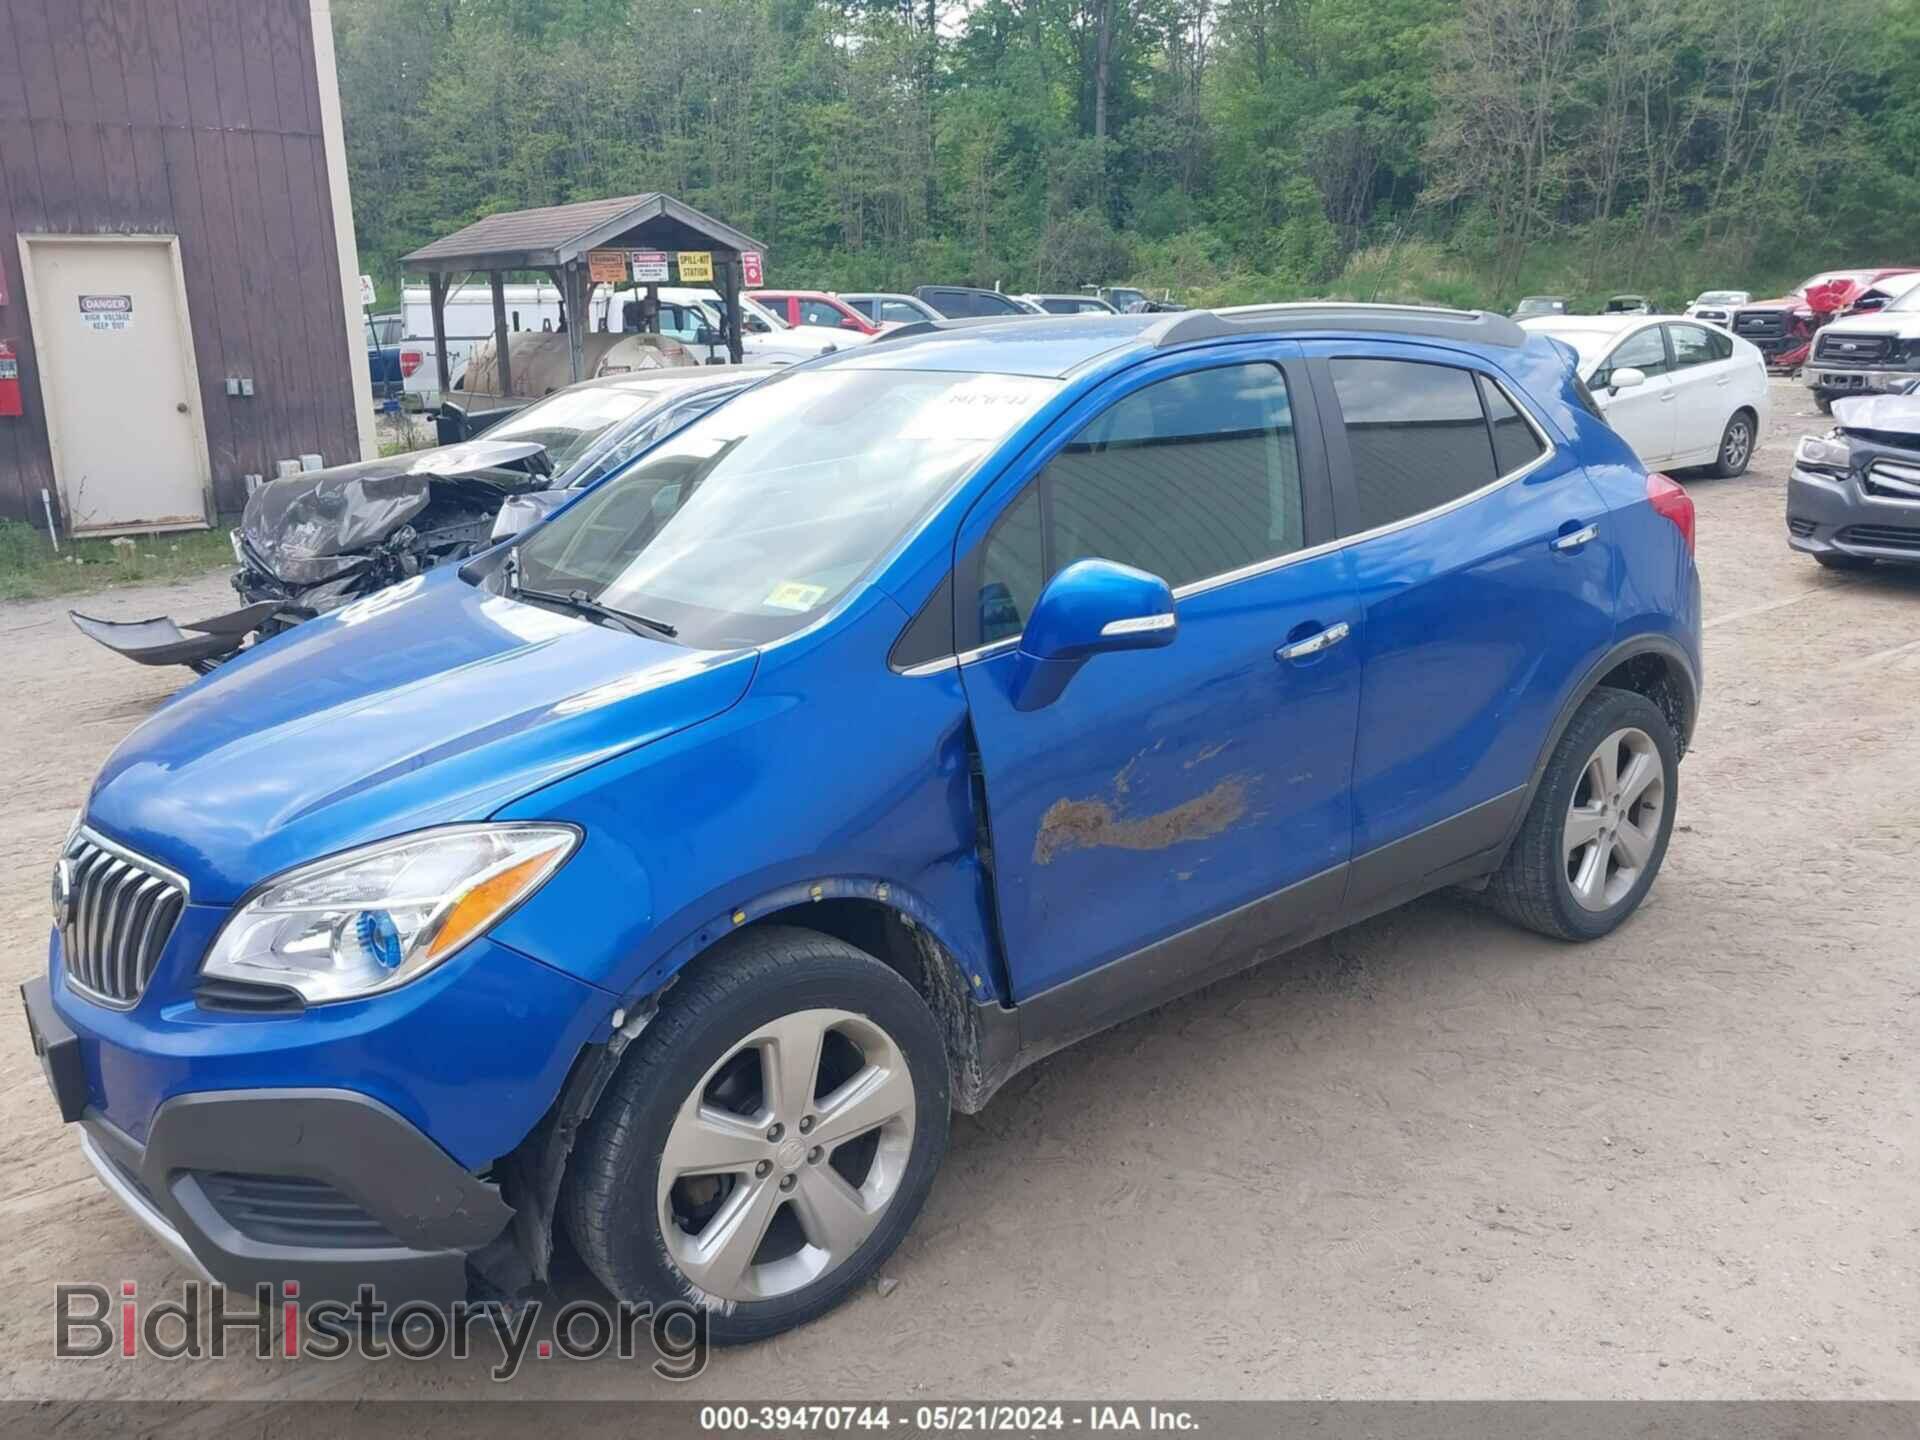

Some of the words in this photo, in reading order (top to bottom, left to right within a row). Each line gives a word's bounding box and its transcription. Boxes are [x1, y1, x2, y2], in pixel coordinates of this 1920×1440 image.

[680, 254, 710, 265] SPILL-KIT
[683, 267, 709, 277] STATION
[86, 299, 125, 309] DANGER
